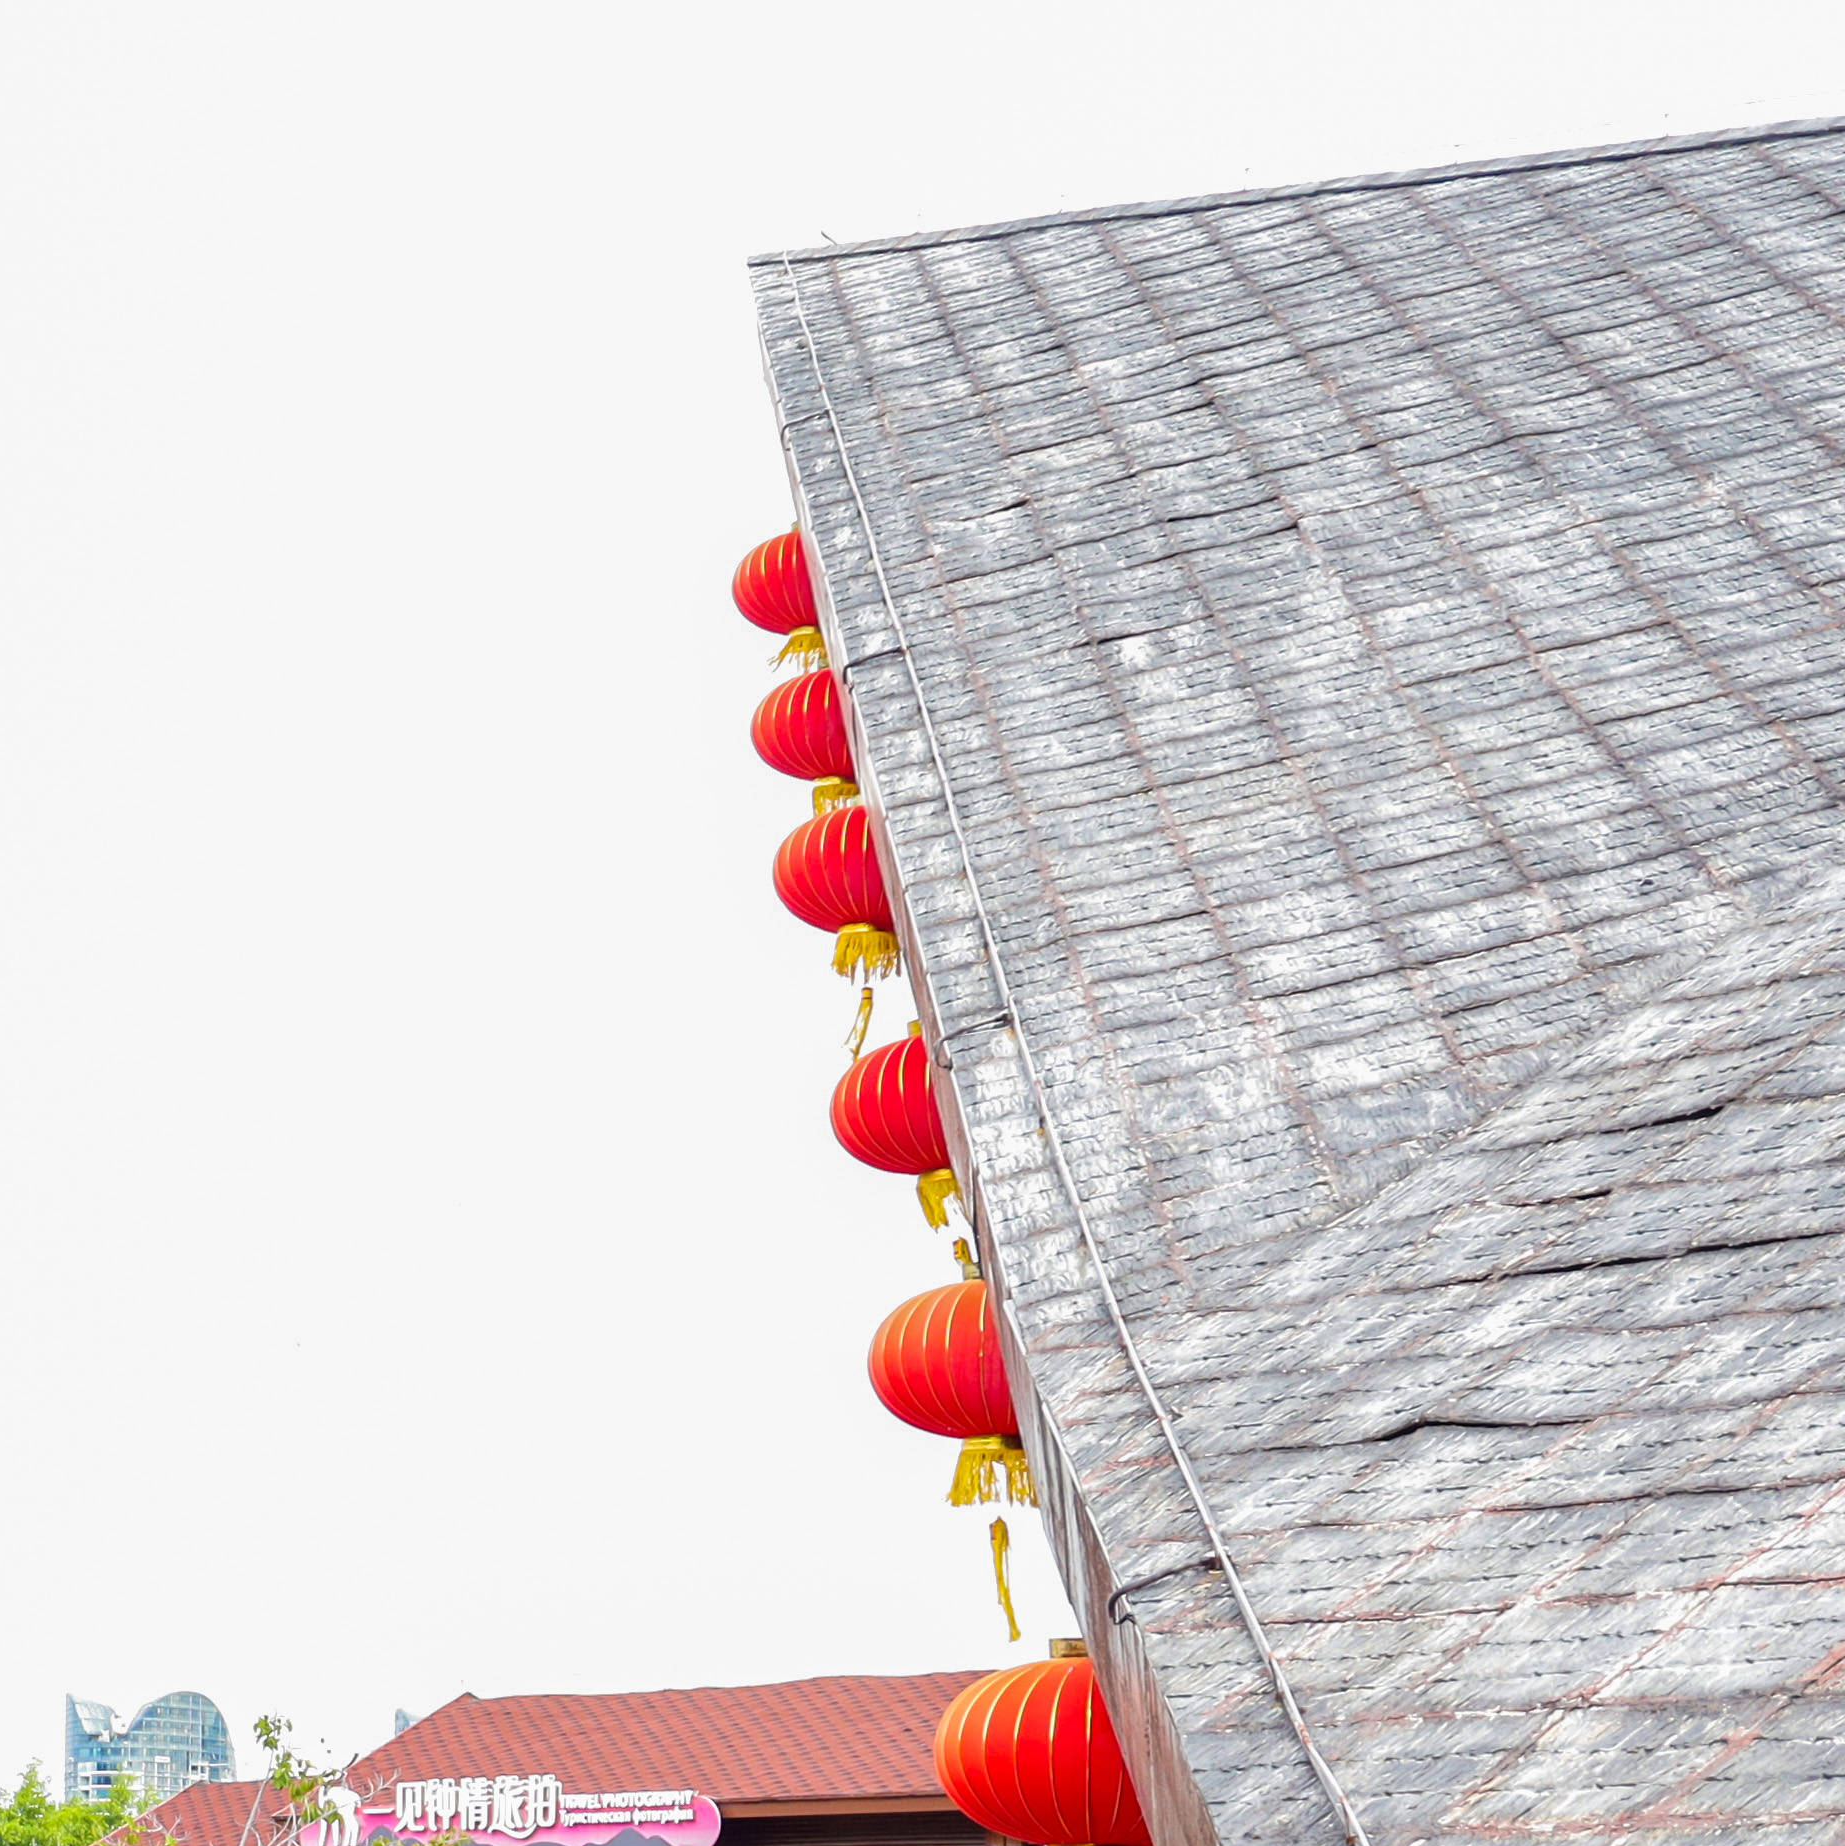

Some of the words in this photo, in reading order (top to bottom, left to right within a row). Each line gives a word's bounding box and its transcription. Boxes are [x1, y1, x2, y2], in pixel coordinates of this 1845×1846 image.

[363, 1774, 562, 1840] 一见钟情旅拍
[559, 1793, 600, 1809] TRAVEL
[601, 1790, 694, 1808] PHOTOGRAPHY
